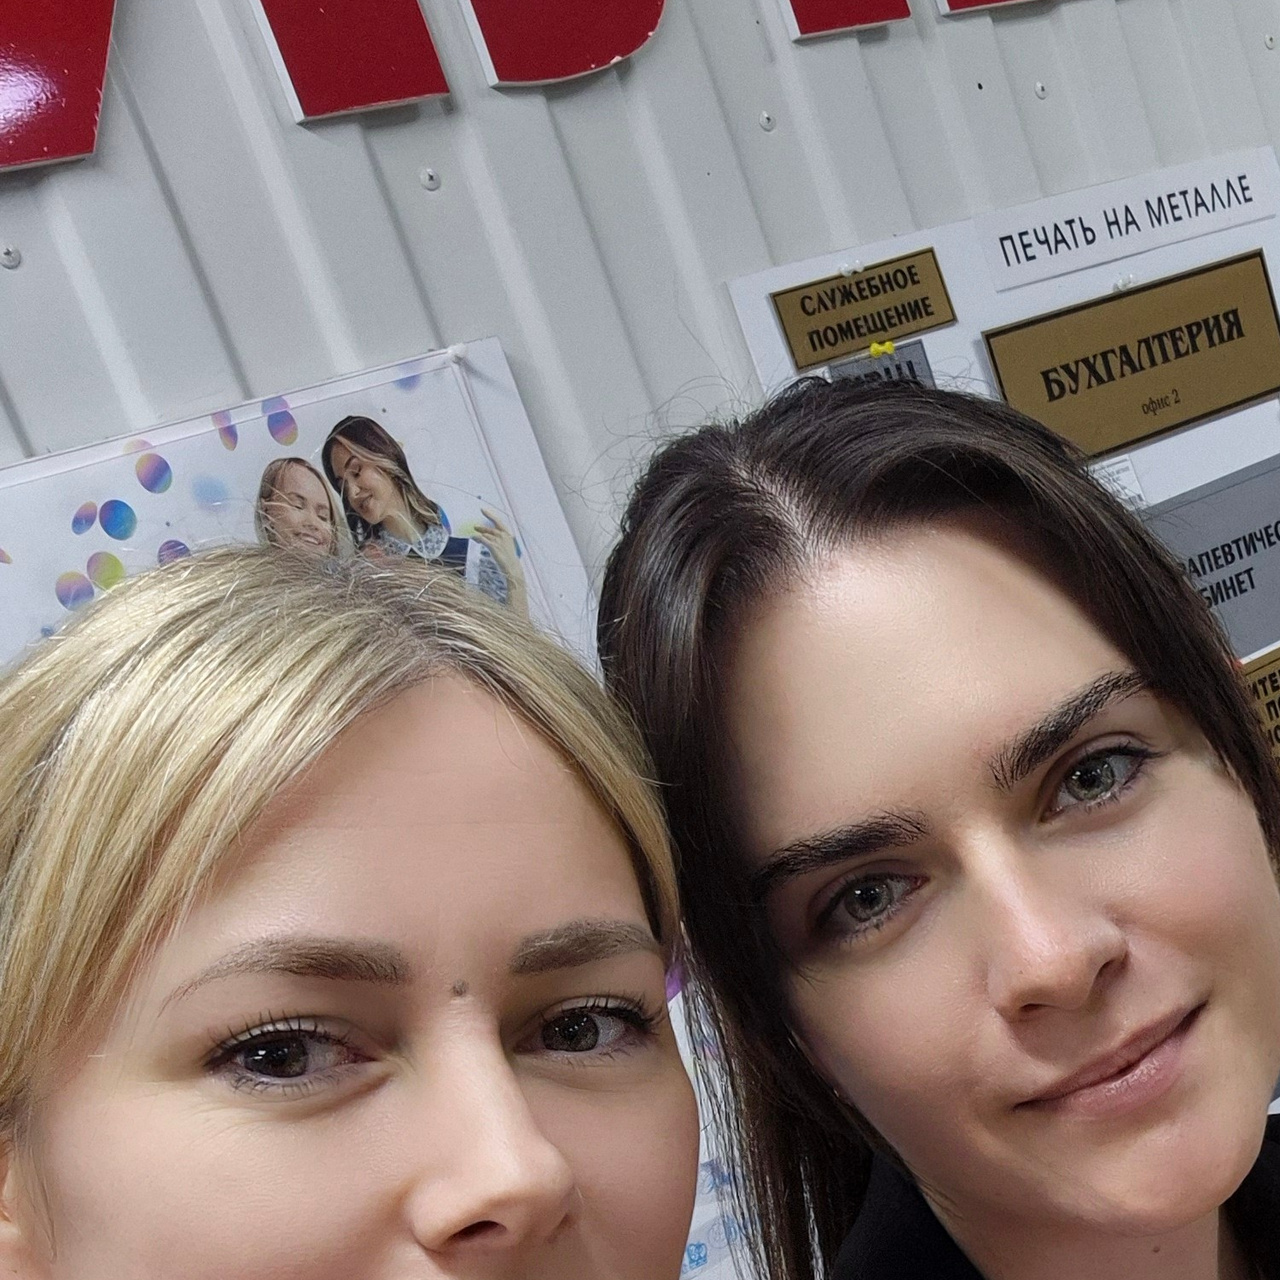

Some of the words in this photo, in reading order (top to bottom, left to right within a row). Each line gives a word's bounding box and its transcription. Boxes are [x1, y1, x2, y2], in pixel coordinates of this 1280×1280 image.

[999, 216, 1097, 267] ПЕЧАТЬ
[1103, 205, 1141, 240] НА
[1145, 174, 1253, 229] МЕТАЛЛЕ
[800, 264, 921, 317] СЛУЖЕБНОЕ
[807, 296, 935, 352] ПОМЕЩЕНИЕ
[1039, 307, 1246, 403] БУХГАЛТЕРИЯ
[1142, 394, 1170, 416] офис
[1172, 388, 1182, 404] 2
